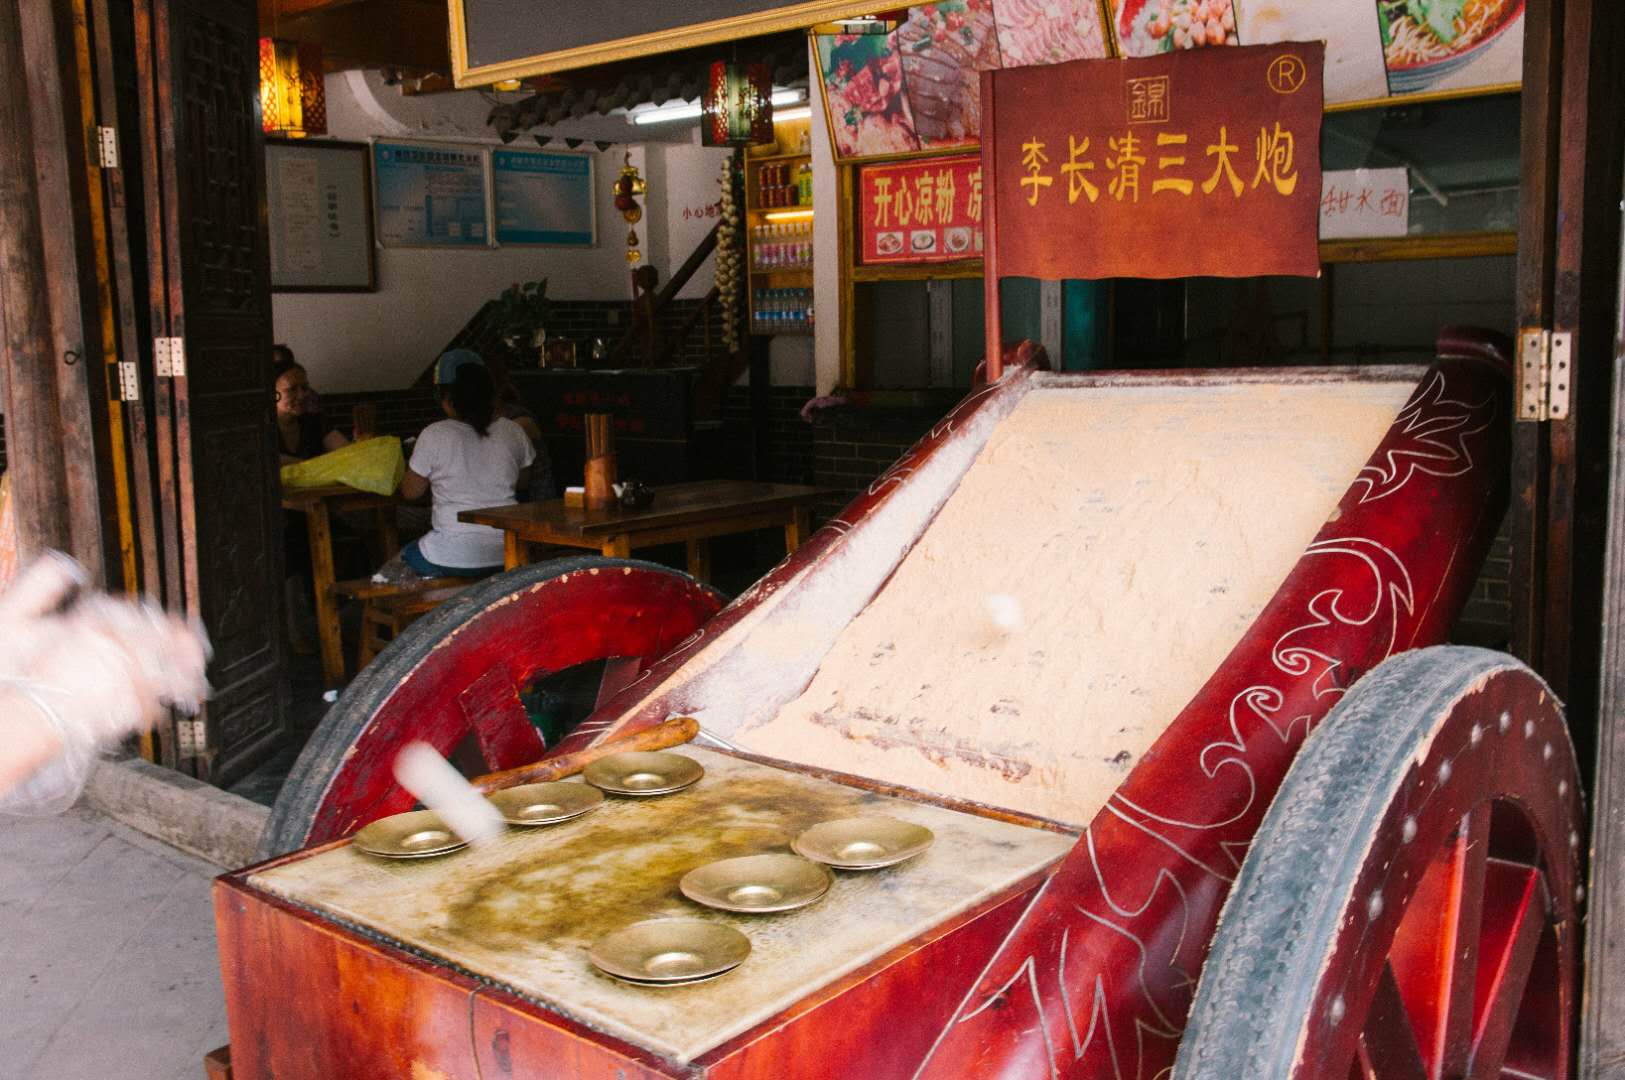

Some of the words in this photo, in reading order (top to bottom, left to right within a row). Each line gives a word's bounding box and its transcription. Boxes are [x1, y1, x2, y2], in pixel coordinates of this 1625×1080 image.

[1020, 122, 1298, 207] 李长清三大炮
[873, 168, 956, 228] 开心凉粉
[1321, 185, 1405, 218] 甜水面
